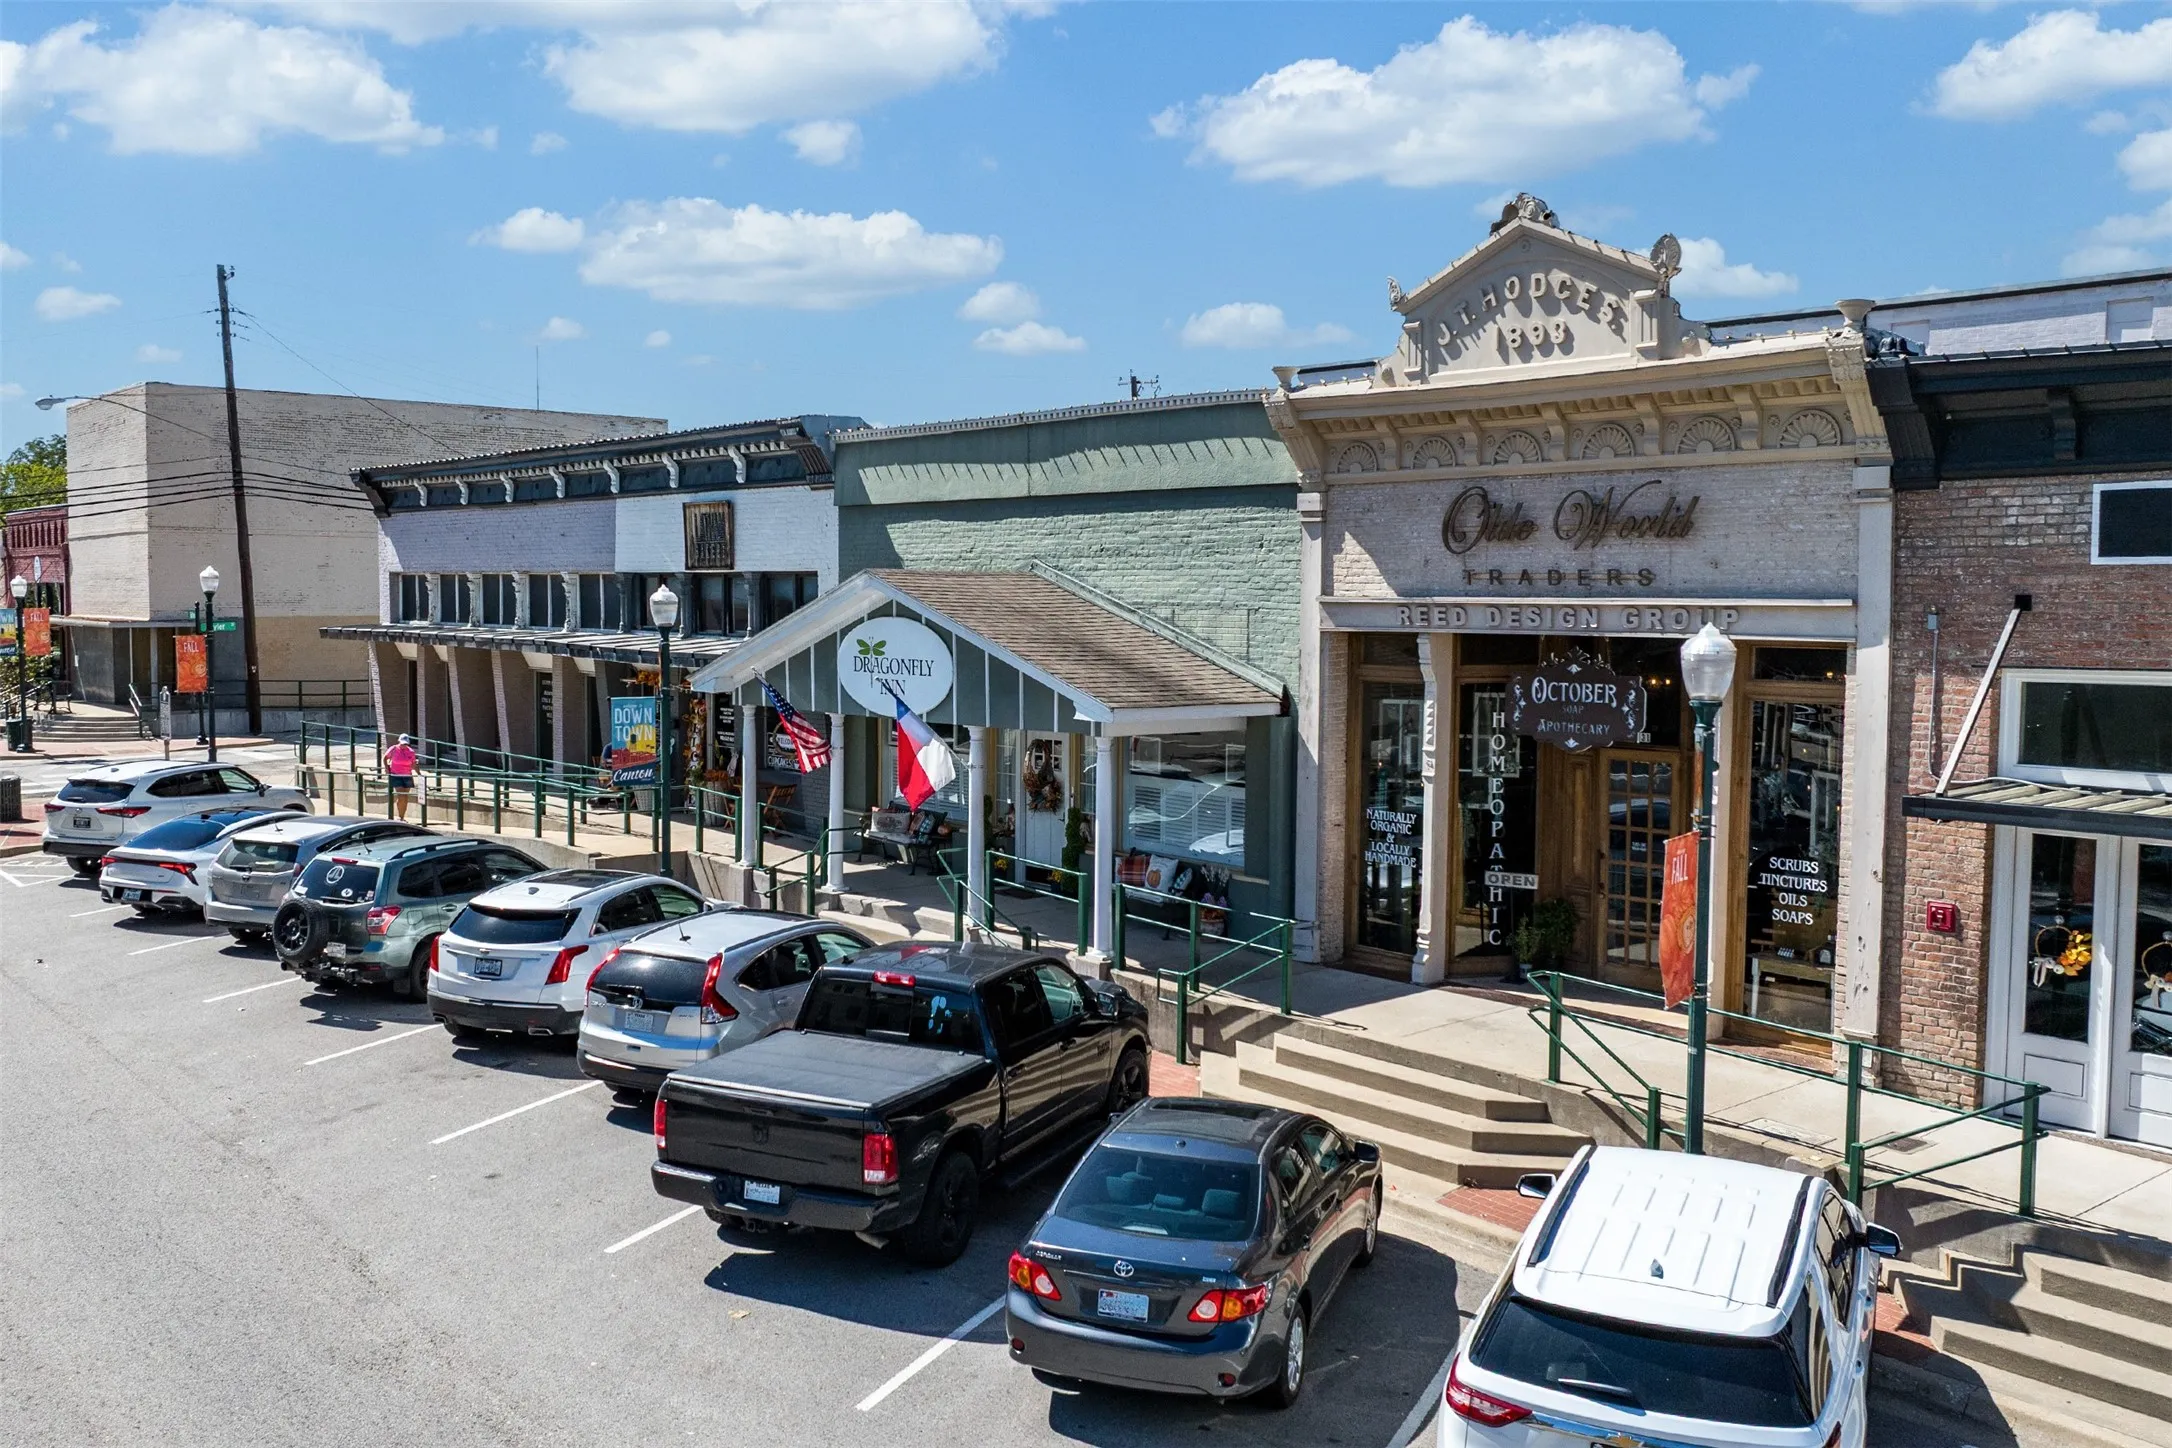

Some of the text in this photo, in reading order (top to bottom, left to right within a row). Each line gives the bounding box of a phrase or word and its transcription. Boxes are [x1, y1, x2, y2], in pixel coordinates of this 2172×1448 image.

[1441, 479, 1702, 554] Olde World
[1462, 567, 1656, 587] TRADERS
[1396, 605, 1740, 631] REED DESIGN GROUP
[183, 642, 200, 653] FALL
[853, 655, 935, 677] DRAGONFLY
[880, 678, 906, 696] INN
[614, 707, 653, 724] DOWN
[1562, 704, 1585, 715] SOAP
[614, 725, 653, 742] TOWN
[1537, 718, 1611, 736] APOTHECARY
[613, 768, 654, 782] Canton
[1366, 808, 1417, 825] NATURALLY
[1370, 819, 1412, 835] ORGANIC
[1386, 832, 1396, 843] &
[1371, 841, 1410, 856] LOCALLY
[1364, 850, 1417, 868] HANDMADE
[1769, 856, 1819, 874] SCRUBS
[1671, 853, 1689, 885] FALL
[1487, 873, 1536, 887] OPEN
[1759, 872, 1828, 893] TINCTURES
[1779, 892, 1808, 907] OILS
[1771, 908, 1814, 925] SOAPS
